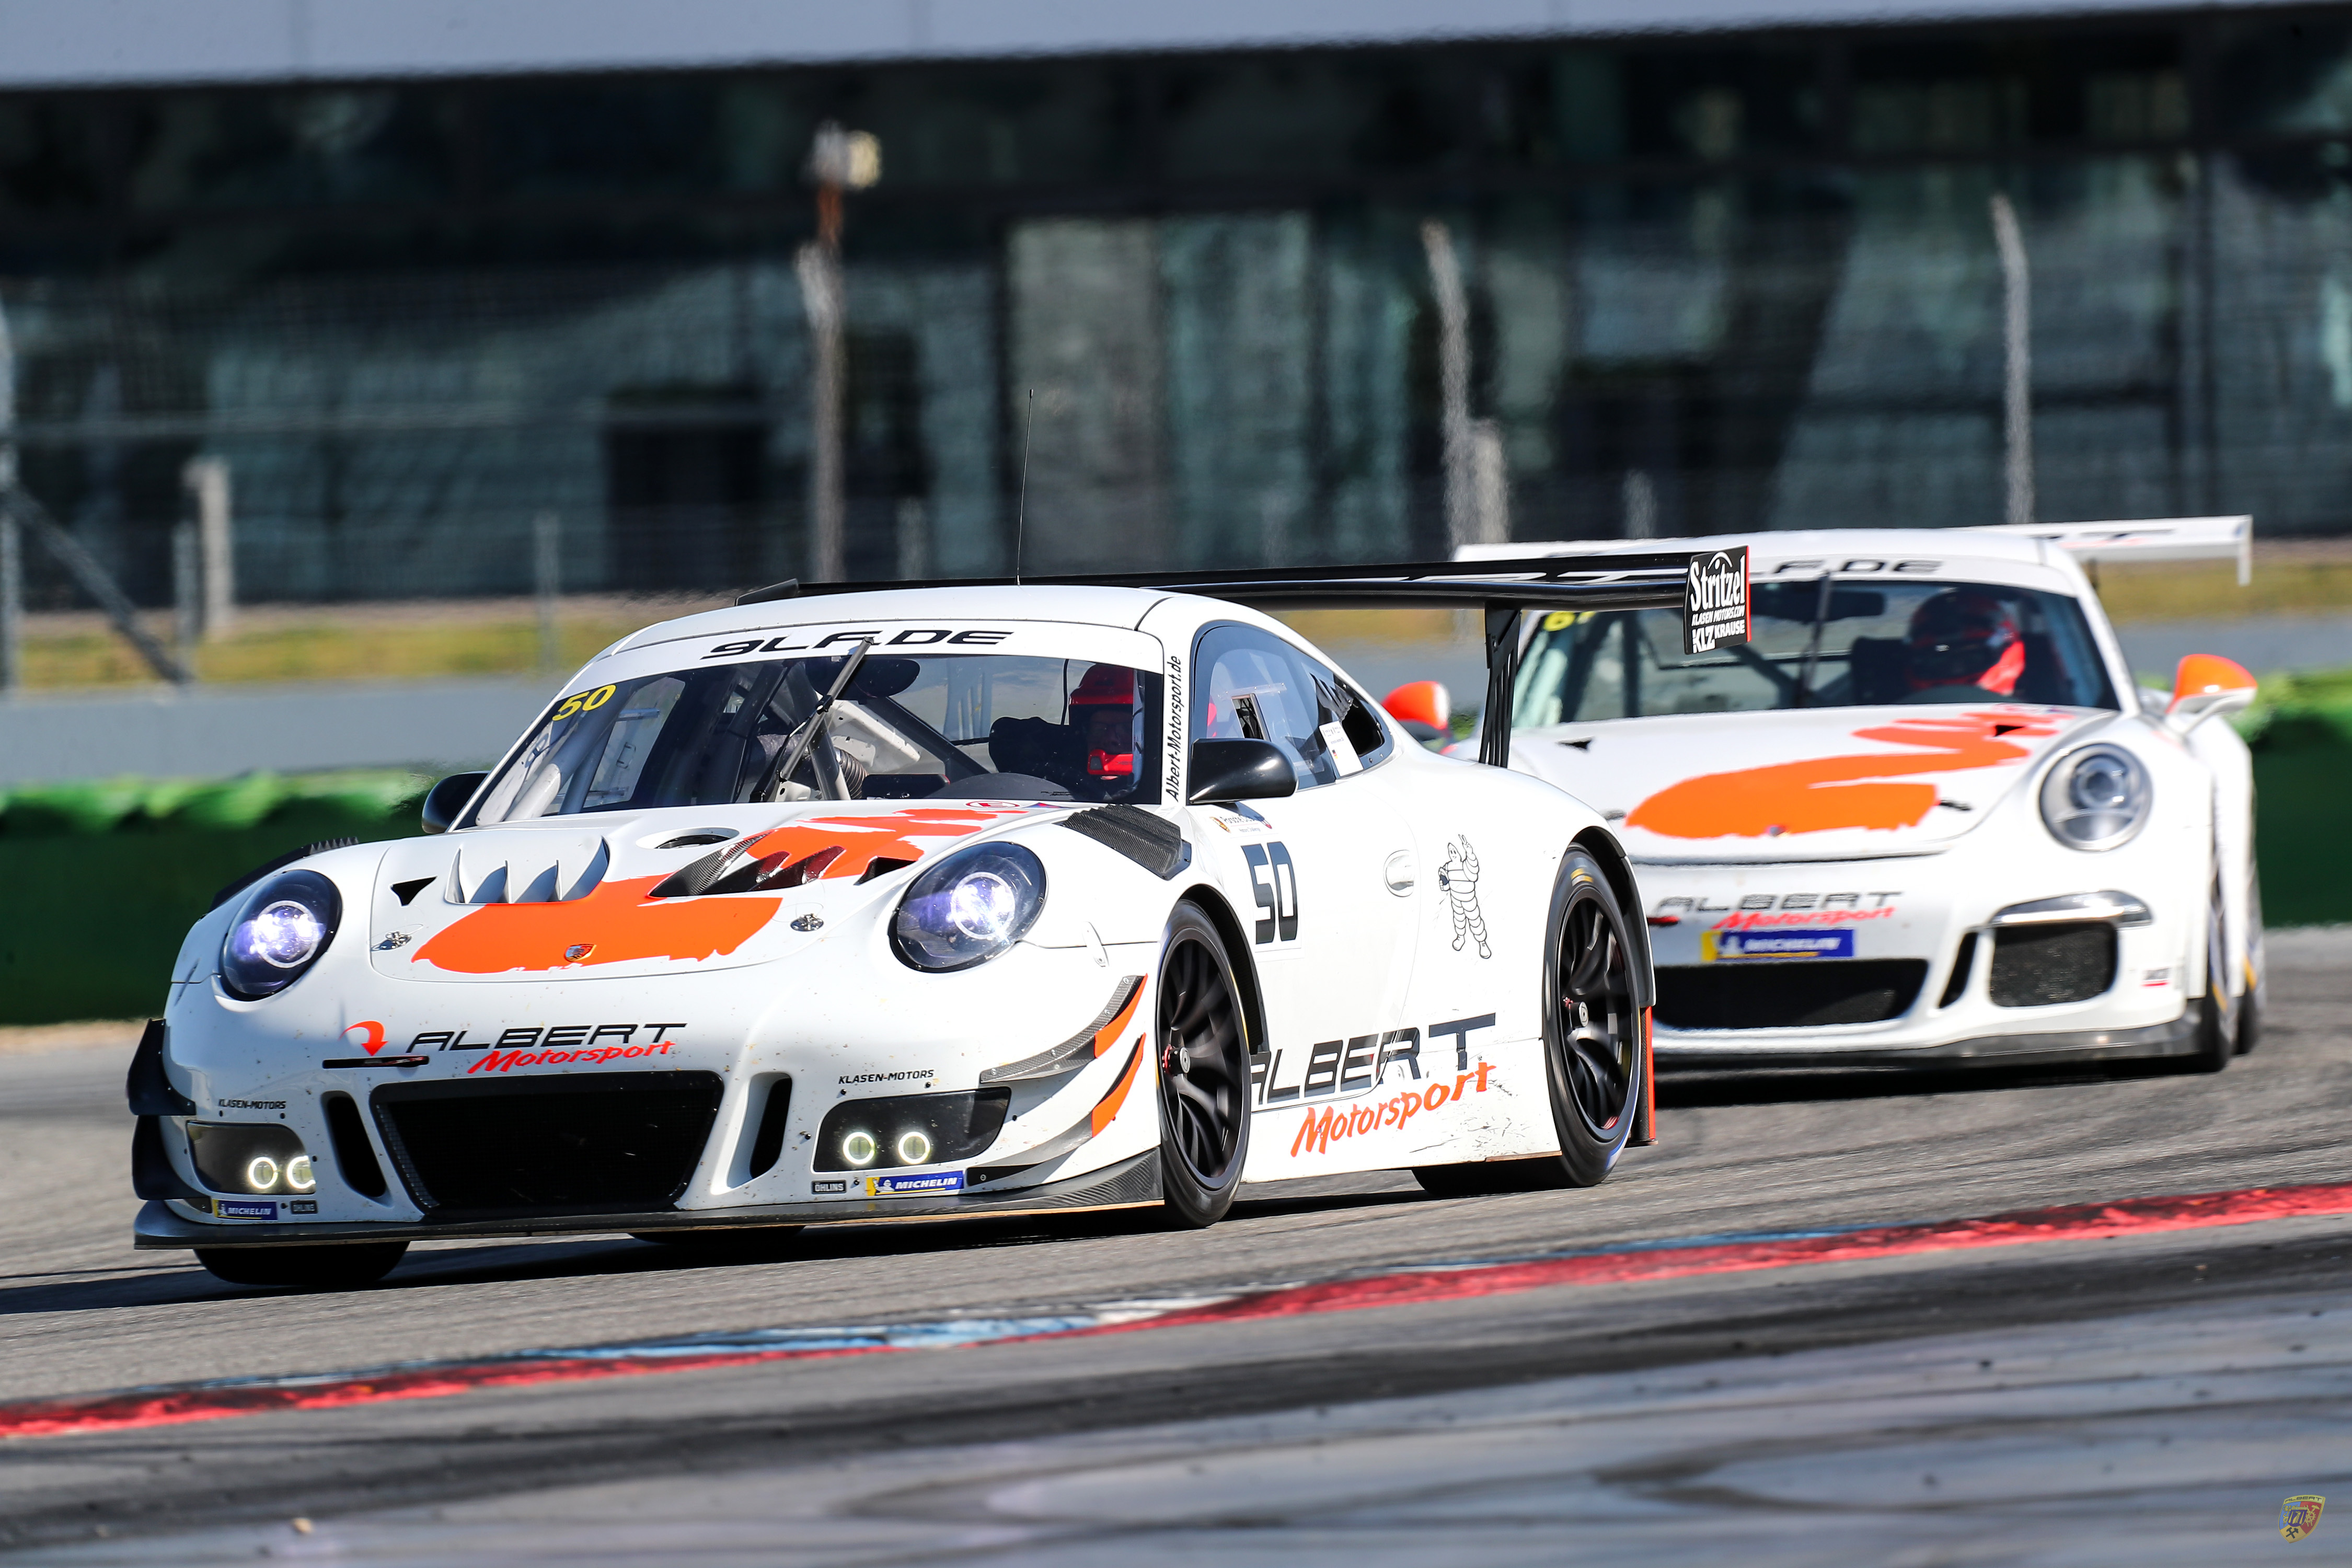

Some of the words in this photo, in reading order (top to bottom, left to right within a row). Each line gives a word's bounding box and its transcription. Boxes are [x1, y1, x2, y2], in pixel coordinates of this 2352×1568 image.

[1690, 555, 1745, 612] Stritzel
[1691, 610, 1714, 626] KLASEN
[1692, 625, 1715, 653] KLZ
[1714, 619, 1745, 639] KRAUSE
[552, 684, 617, 721] 50
[1166, 655, 1184, 803] Albert-Motorsport.de
[1241, 841, 1298, 944] 50
[1653, 892, 1901, 915] ALBERT
[1711, 906, 1897, 931] Motorsport
[406, 1023, 688, 1053] ALBERT
[468, 1040, 676, 1074] Motorsport
[838, 1069, 934, 1085] KLASEN-MOTORS
[218, 1099, 286, 1110] KLASEN-MOTORS
[1290, 1062, 1497, 1157] Motorsport
[895, 1177, 958, 1190] MICHELIN
